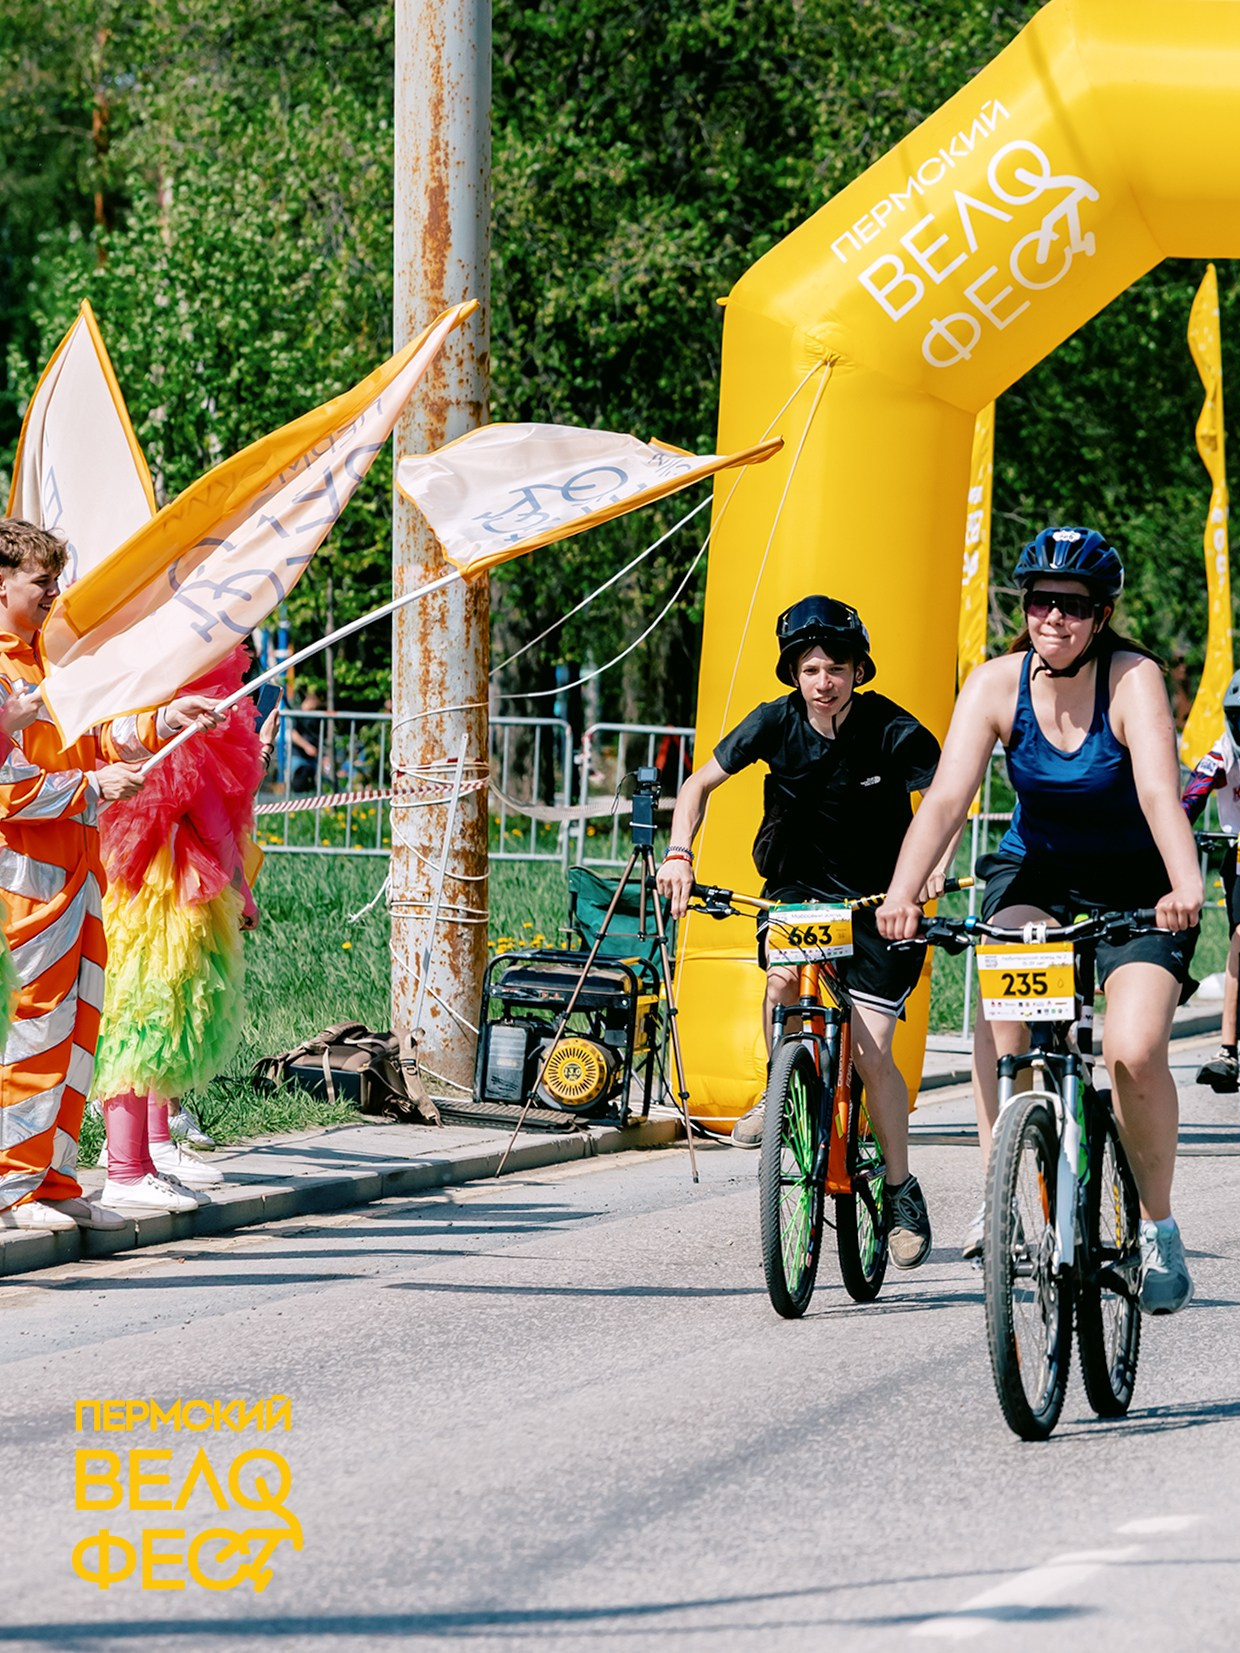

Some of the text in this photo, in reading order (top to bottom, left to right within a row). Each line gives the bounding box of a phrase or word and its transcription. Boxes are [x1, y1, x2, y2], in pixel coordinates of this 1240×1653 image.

[830, 98, 1011, 263] ПЕРМСКИЙ
[857, 139, 1051, 323] ВЕЛО
[921, 184, 1096, 368] ФЕСТ
[788, 925, 833, 946] 663
[1001, 971, 1048, 996] 235
